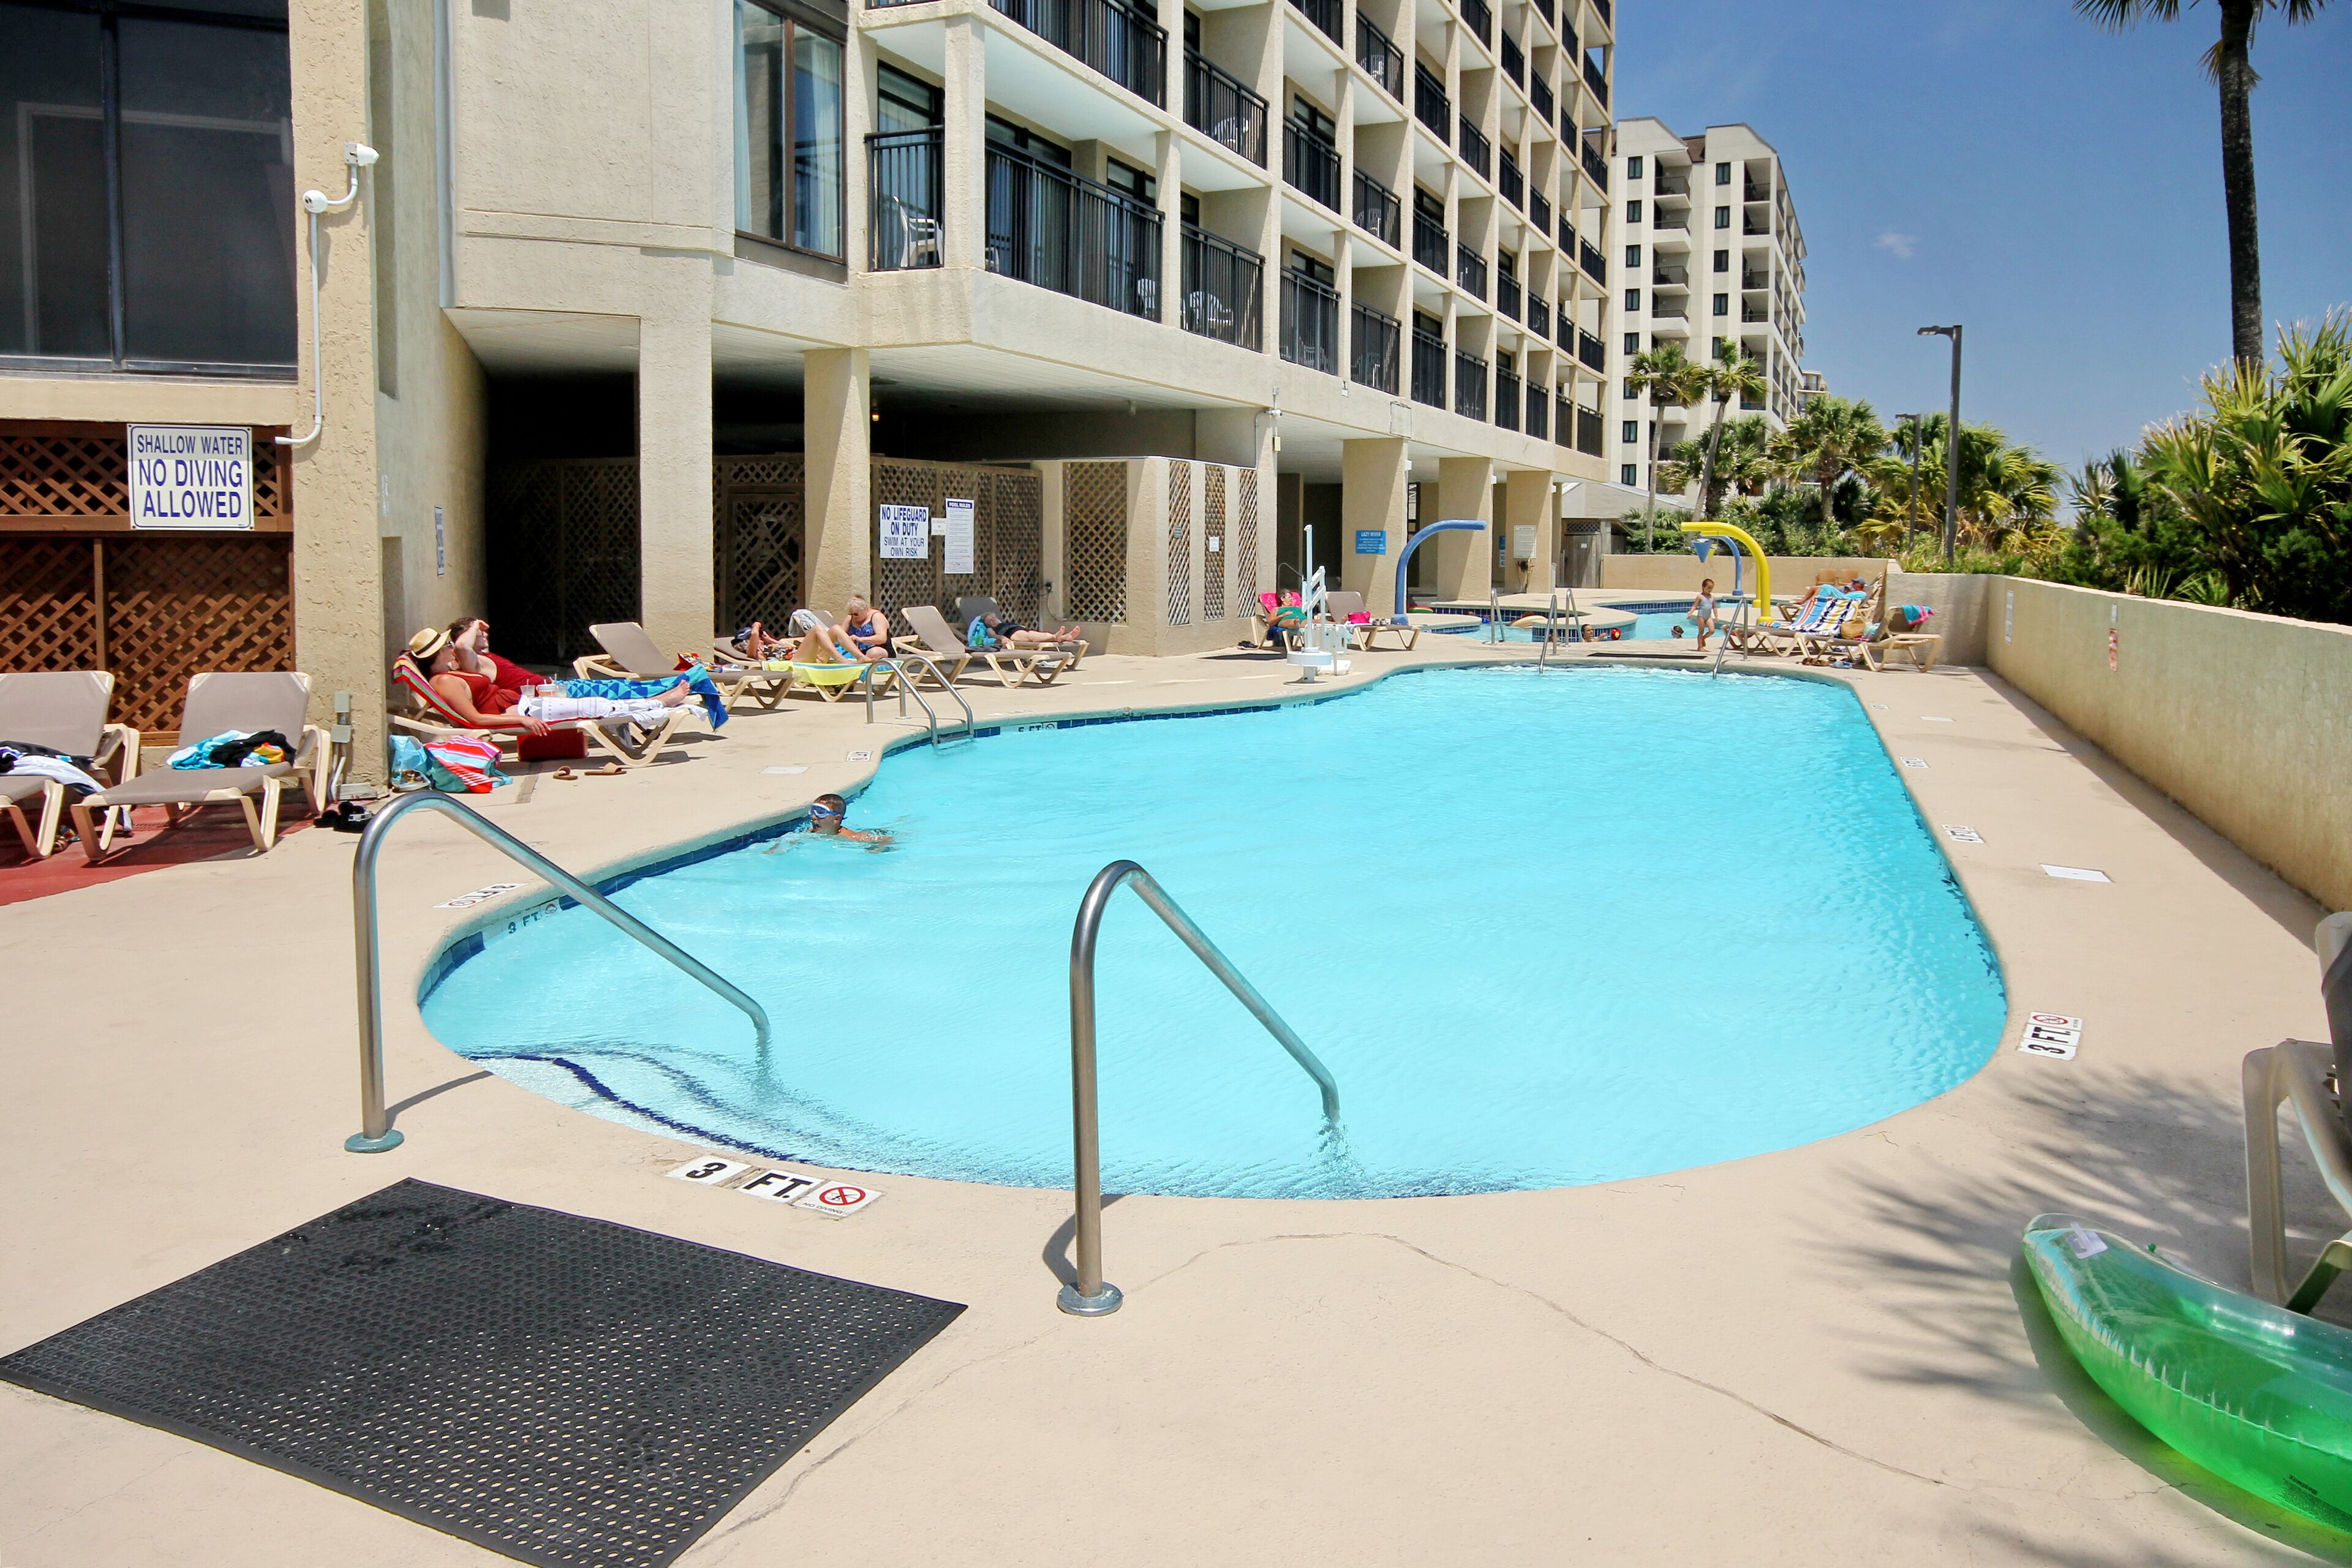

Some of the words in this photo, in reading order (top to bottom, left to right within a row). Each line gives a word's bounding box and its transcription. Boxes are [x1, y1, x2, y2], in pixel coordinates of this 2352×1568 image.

[137, 434, 196, 454] SHALLOW
[201, 436, 243, 454] WATER
[138, 459, 167, 486] NO
[175, 459, 243, 488] DIVING
[143, 490, 241, 518] ALLOWED
[882, 507, 891, 520] NO
[894, 507, 927, 522] LIFEGUARD
[891, 522, 899, 535] ON
[902, 522, 918, 536] DUTY
[884, 537, 899, 546] SWIM
[901, 537, 908, 546] AT
[910, 538, 924, 547] YOUR
[891, 548, 903, 557] OWN
[906, 548, 918, 557] RISK
[2028, 1044, 2066, 1054] 3
[685, 1162, 728, 1179] 3
[743, 1172, 813, 1199] FT.
[816, 1205, 843, 1214] DIVING
